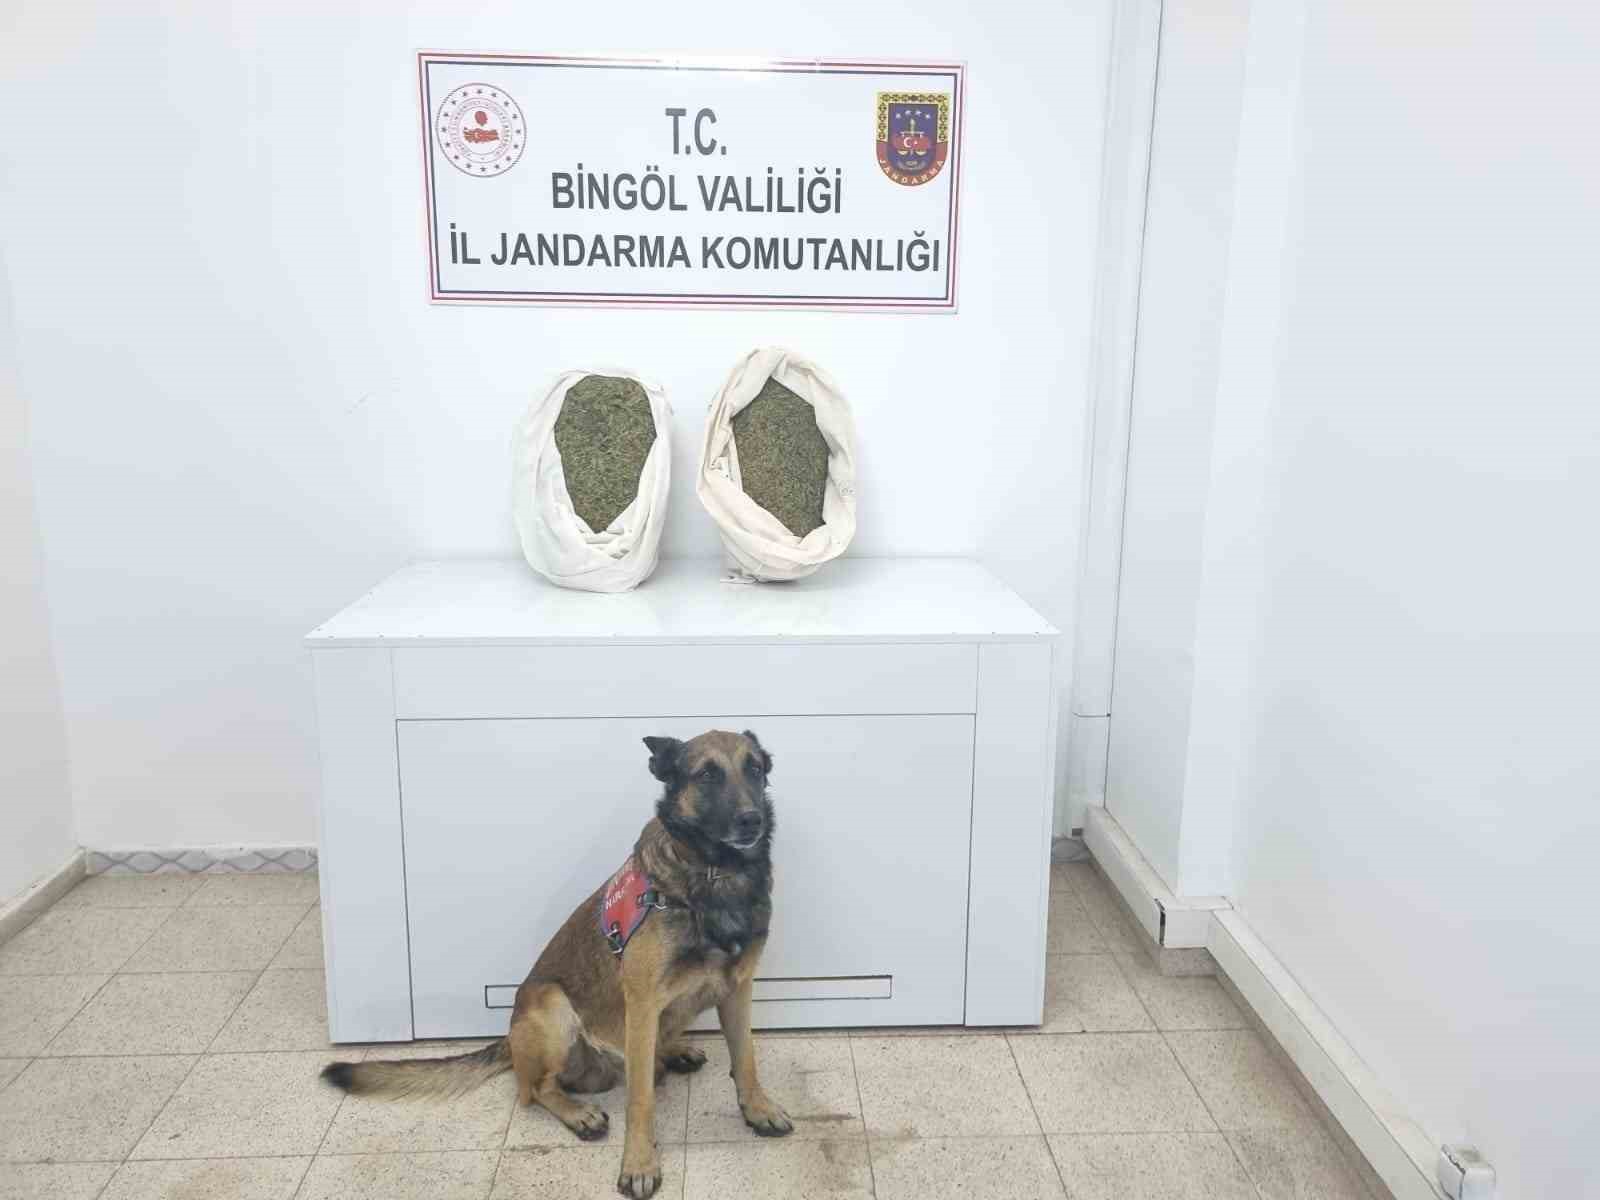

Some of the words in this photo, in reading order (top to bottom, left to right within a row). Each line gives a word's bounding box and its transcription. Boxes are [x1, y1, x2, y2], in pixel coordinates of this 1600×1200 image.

[665, 108, 727, 156] T.C.
[551, 162, 688, 211] BİNGÖL
[696, 166, 842, 214] VALİLİĞİ
[450, 224, 480, 265] İL
[490, 232, 691, 268] JANDARMA
[702, 229, 941, 272] KOMUTANLIĞI
